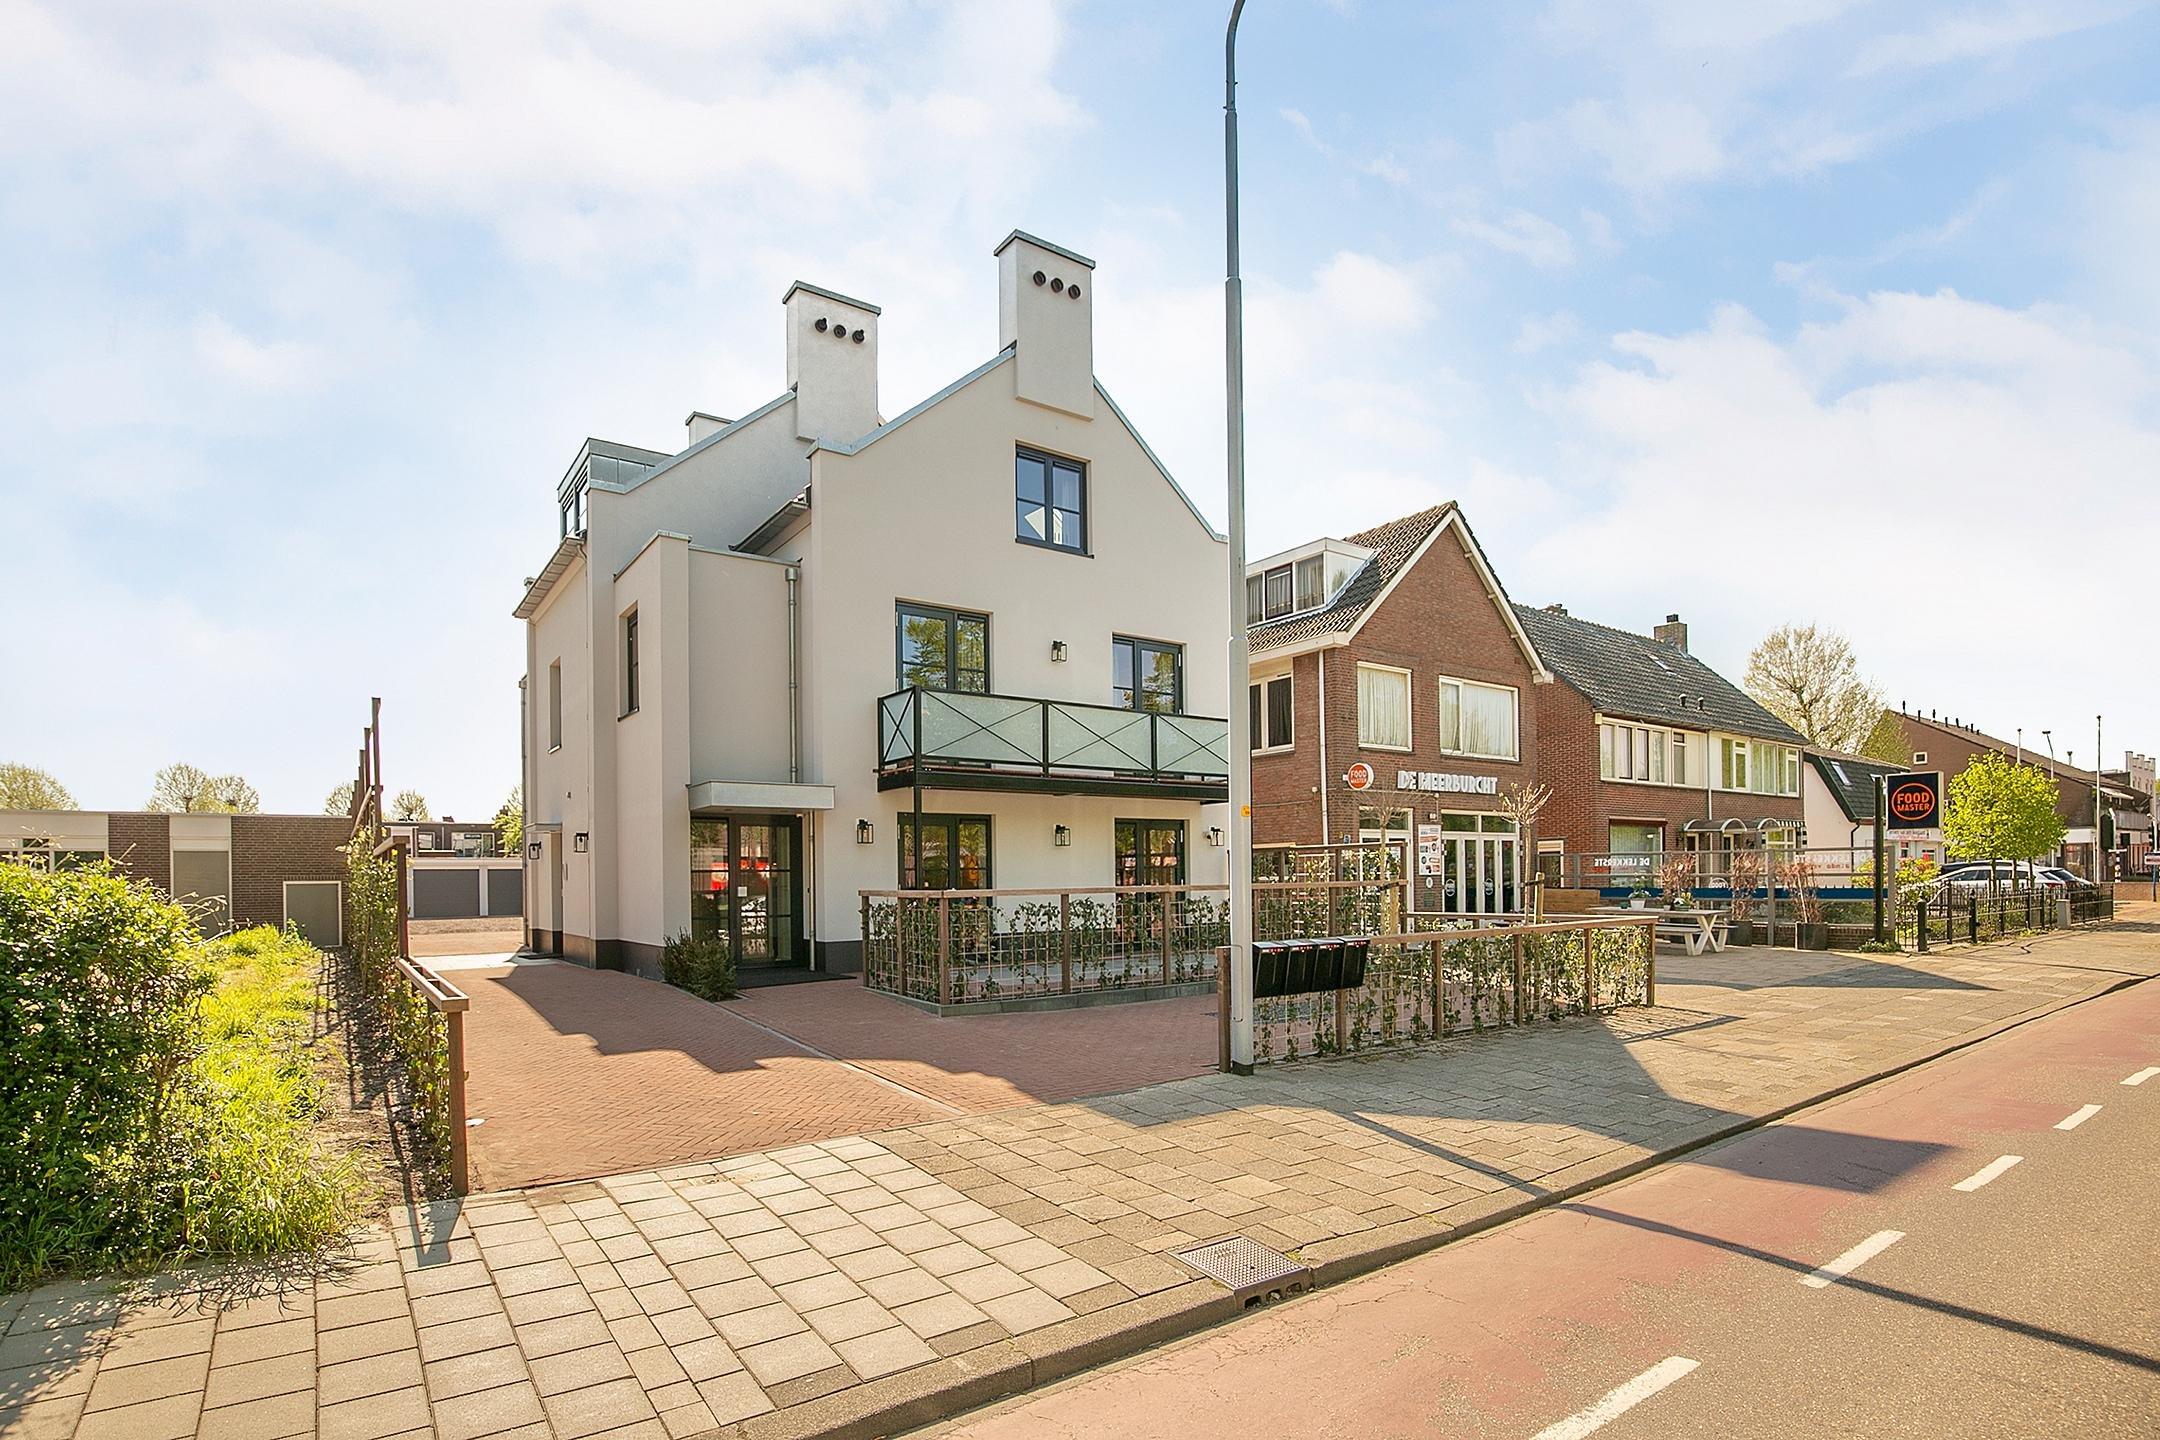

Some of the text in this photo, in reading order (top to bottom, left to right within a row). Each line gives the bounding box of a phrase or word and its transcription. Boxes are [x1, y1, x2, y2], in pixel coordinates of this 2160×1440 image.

[1351, 769, 1367, 778] FOOD
[1397, 770, 1498, 795] DE MEERBURCHT
[1897, 792, 1930, 804] FOOD
[1897, 803, 1930, 811] MASTER
